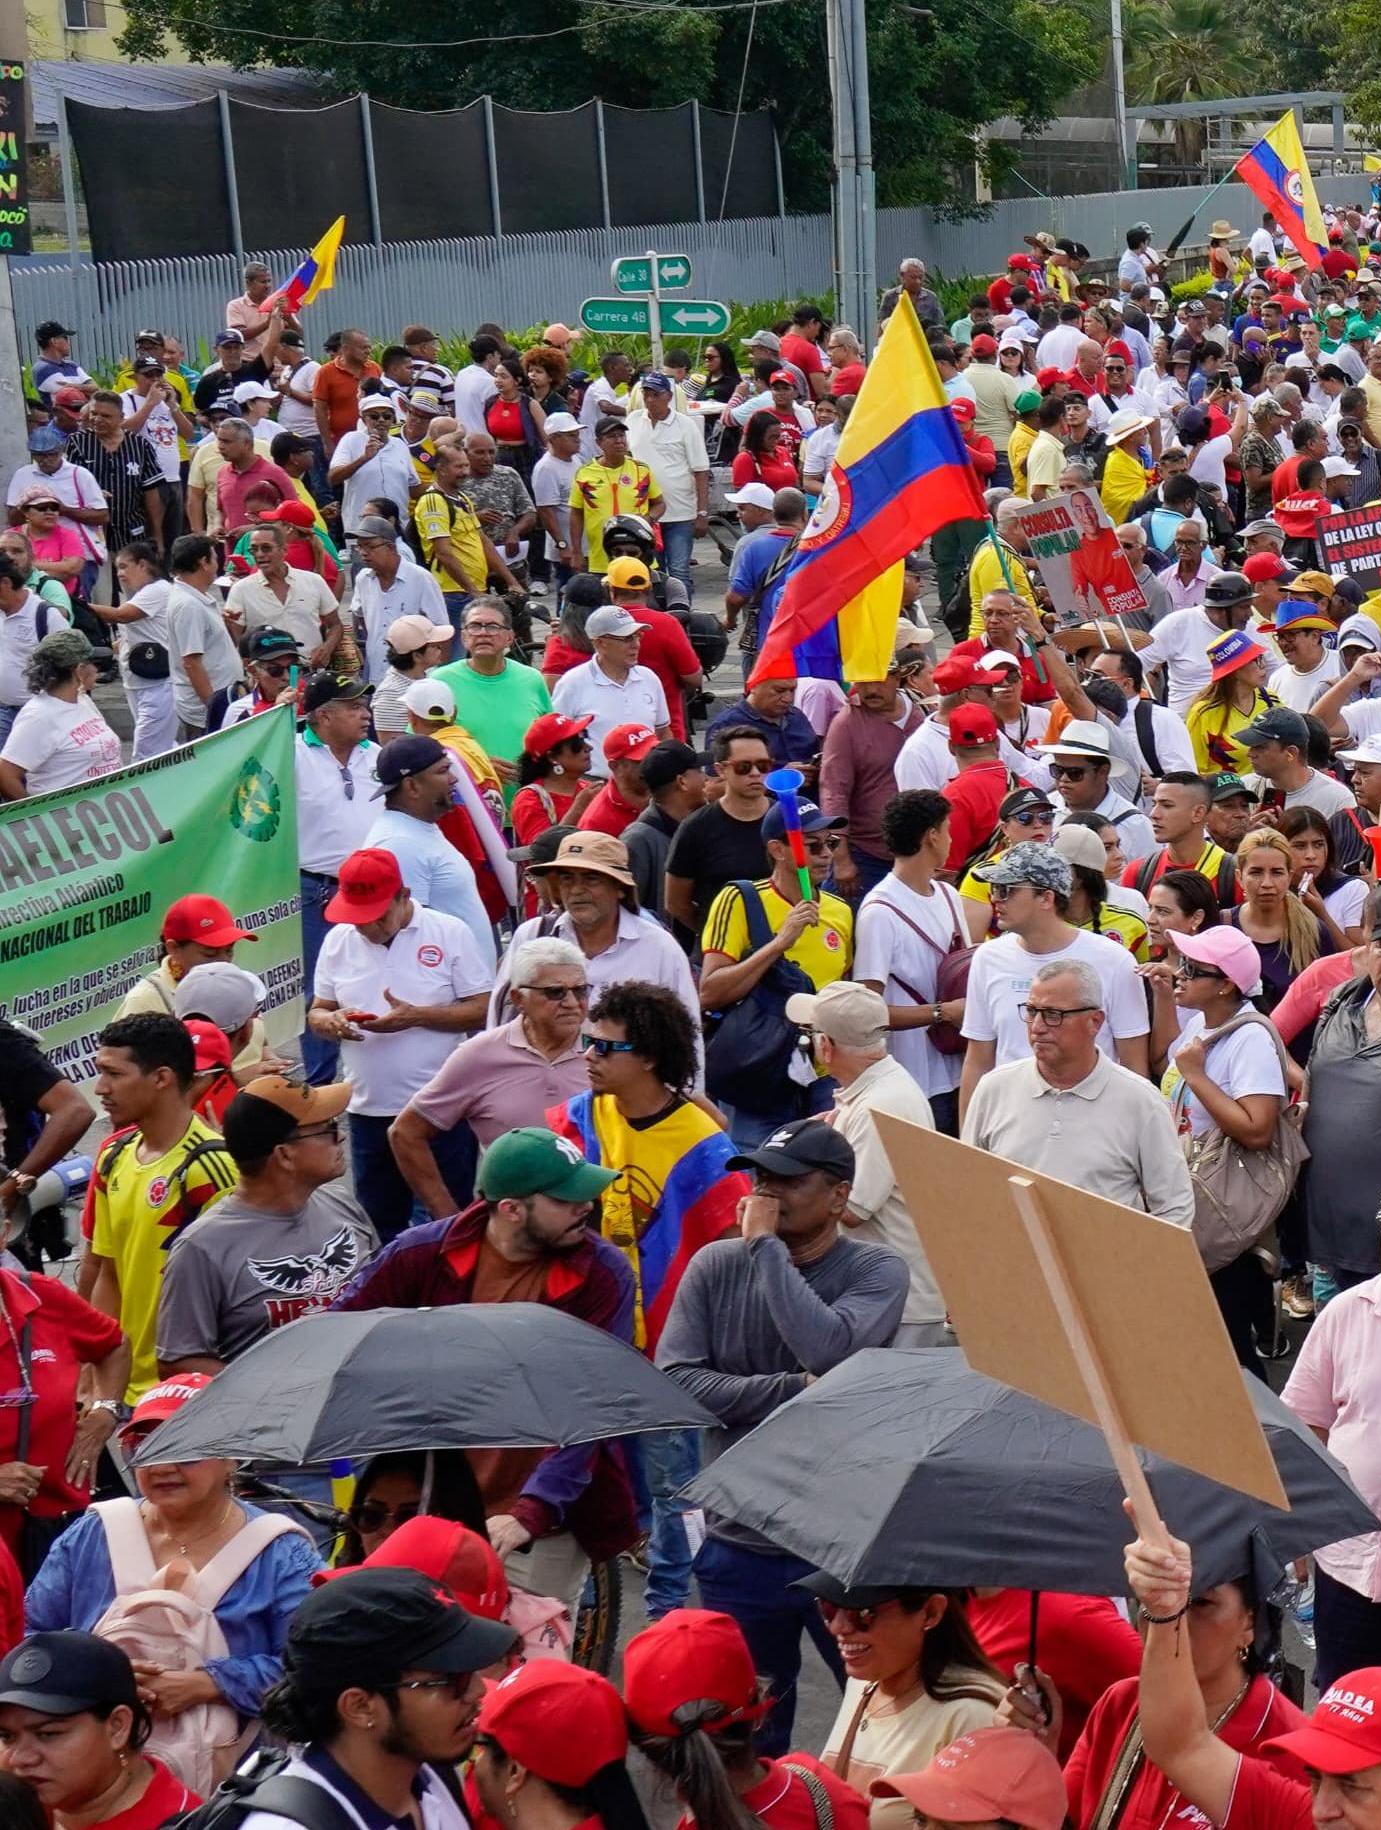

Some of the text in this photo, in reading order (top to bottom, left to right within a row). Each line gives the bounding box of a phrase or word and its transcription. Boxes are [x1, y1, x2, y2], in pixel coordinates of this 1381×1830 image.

[618, 268, 647, 283] Calle 30
[586, 309, 628, 323] Carrera
[1019, 506, 1074, 538] CONSULTA
[1321, 516, 1347, 532] POR
[1348, 511, 1365, 528] LA
[1323, 530, 1339, 547] DE
[1340, 526, 1355, 543] LA
[1355, 521, 1376, 539] LEY
[1030, 529, 1082, 559] POPULAR
[1327, 545, 1342, 562] EL
[1330, 561, 1348, 575] DE
[1214, 639, 1244, 663] COLOMBIA
[57, 872, 125, 911] Atlántico
[73, 910, 98, 938] DEL
[99, 891, 152, 931] TRABAJO
[244, 900, 290, 931] una sola
[13, 964, 120, 1016] lucha en la que se
[26, 1001, 84, 1032] intereses
